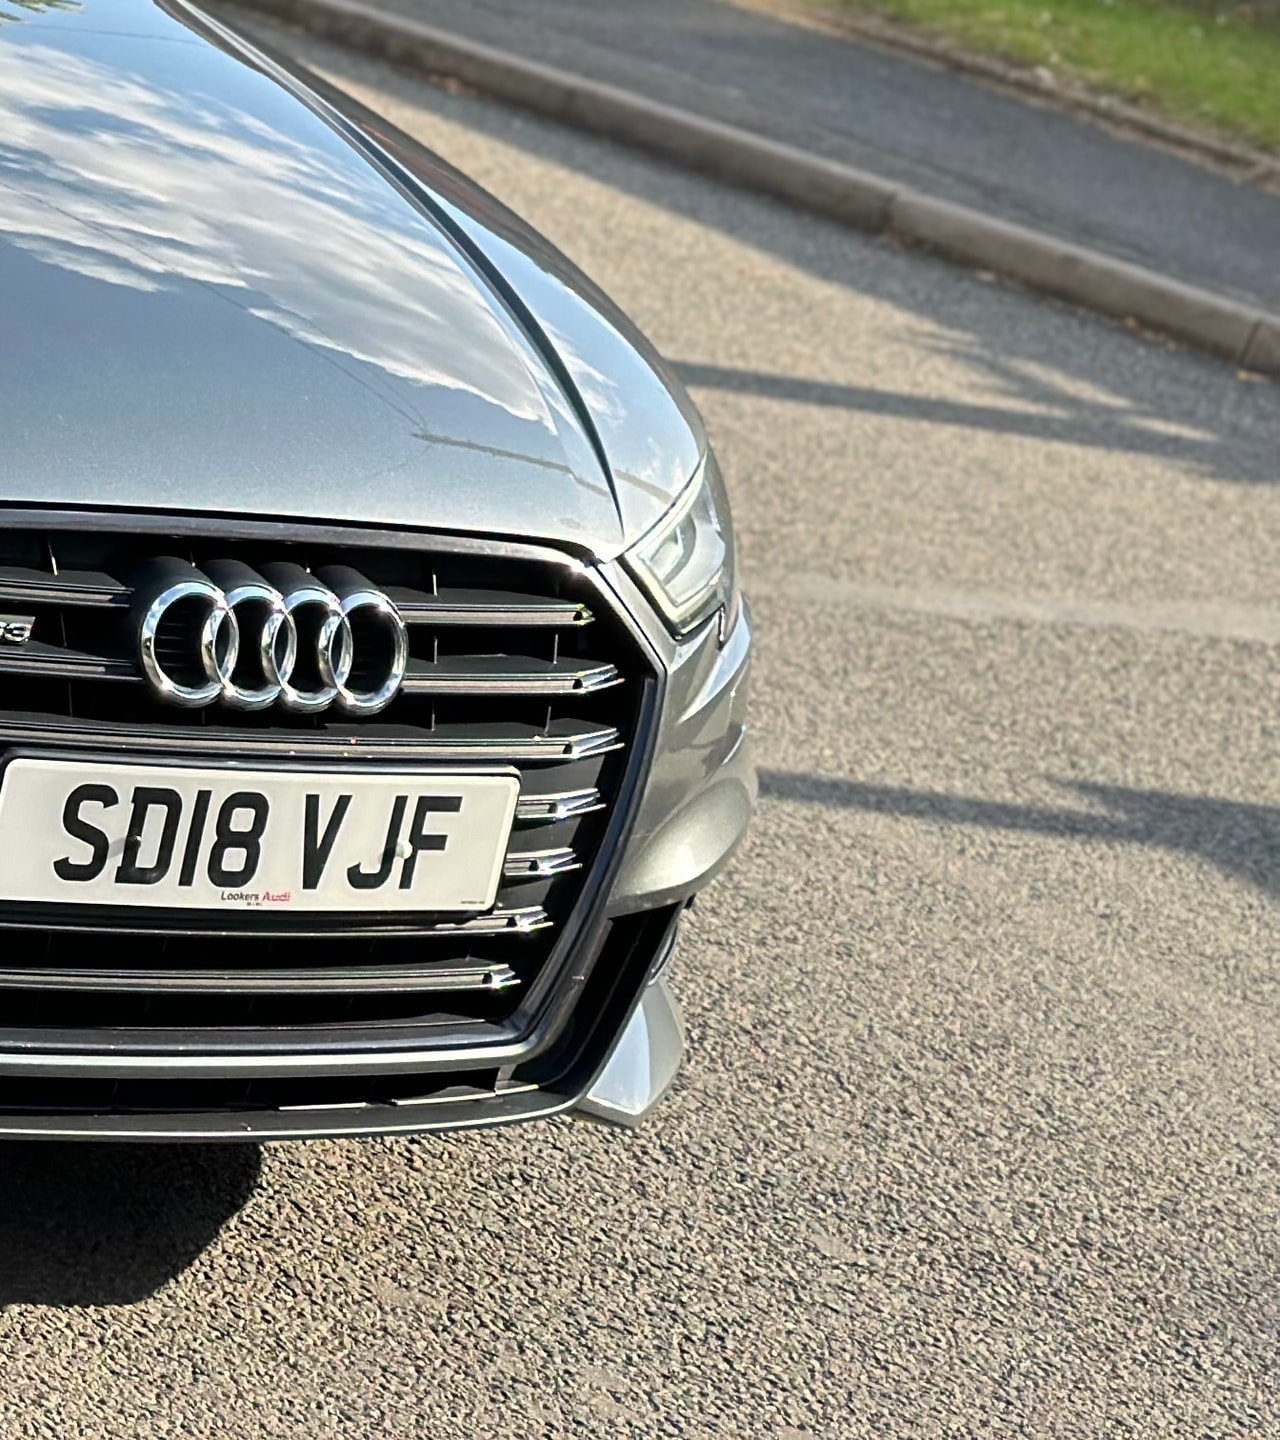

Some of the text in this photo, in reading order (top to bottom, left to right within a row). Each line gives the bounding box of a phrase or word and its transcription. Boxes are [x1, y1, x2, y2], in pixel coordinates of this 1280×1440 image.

[53, 783, 463, 890] SD18 VJF
[221, 891, 291, 902] Lookers Audi
